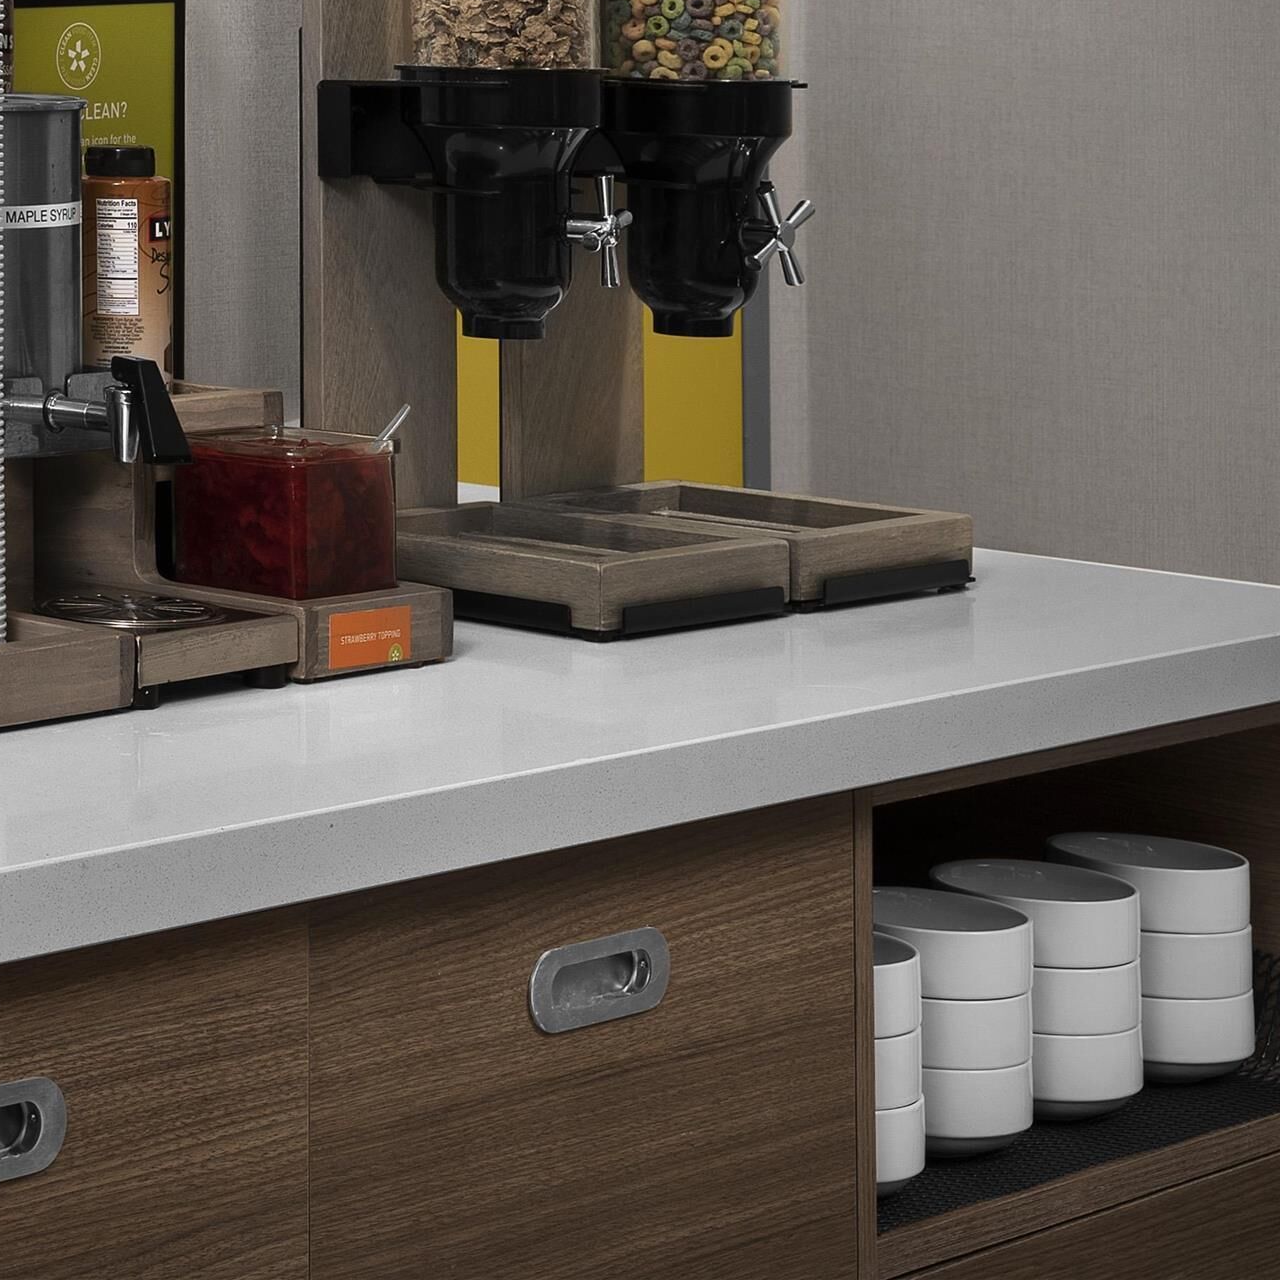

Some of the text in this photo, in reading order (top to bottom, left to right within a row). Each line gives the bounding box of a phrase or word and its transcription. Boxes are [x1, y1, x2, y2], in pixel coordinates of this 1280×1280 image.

[92, 135, 109, 145] icon
[109, 134, 121, 144] for
[123, 133, 137, 143] the
[6, 207, 76, 224] MAPLE SYRUP
[340, 629, 401, 646] STRAWBERRY TOPPING
